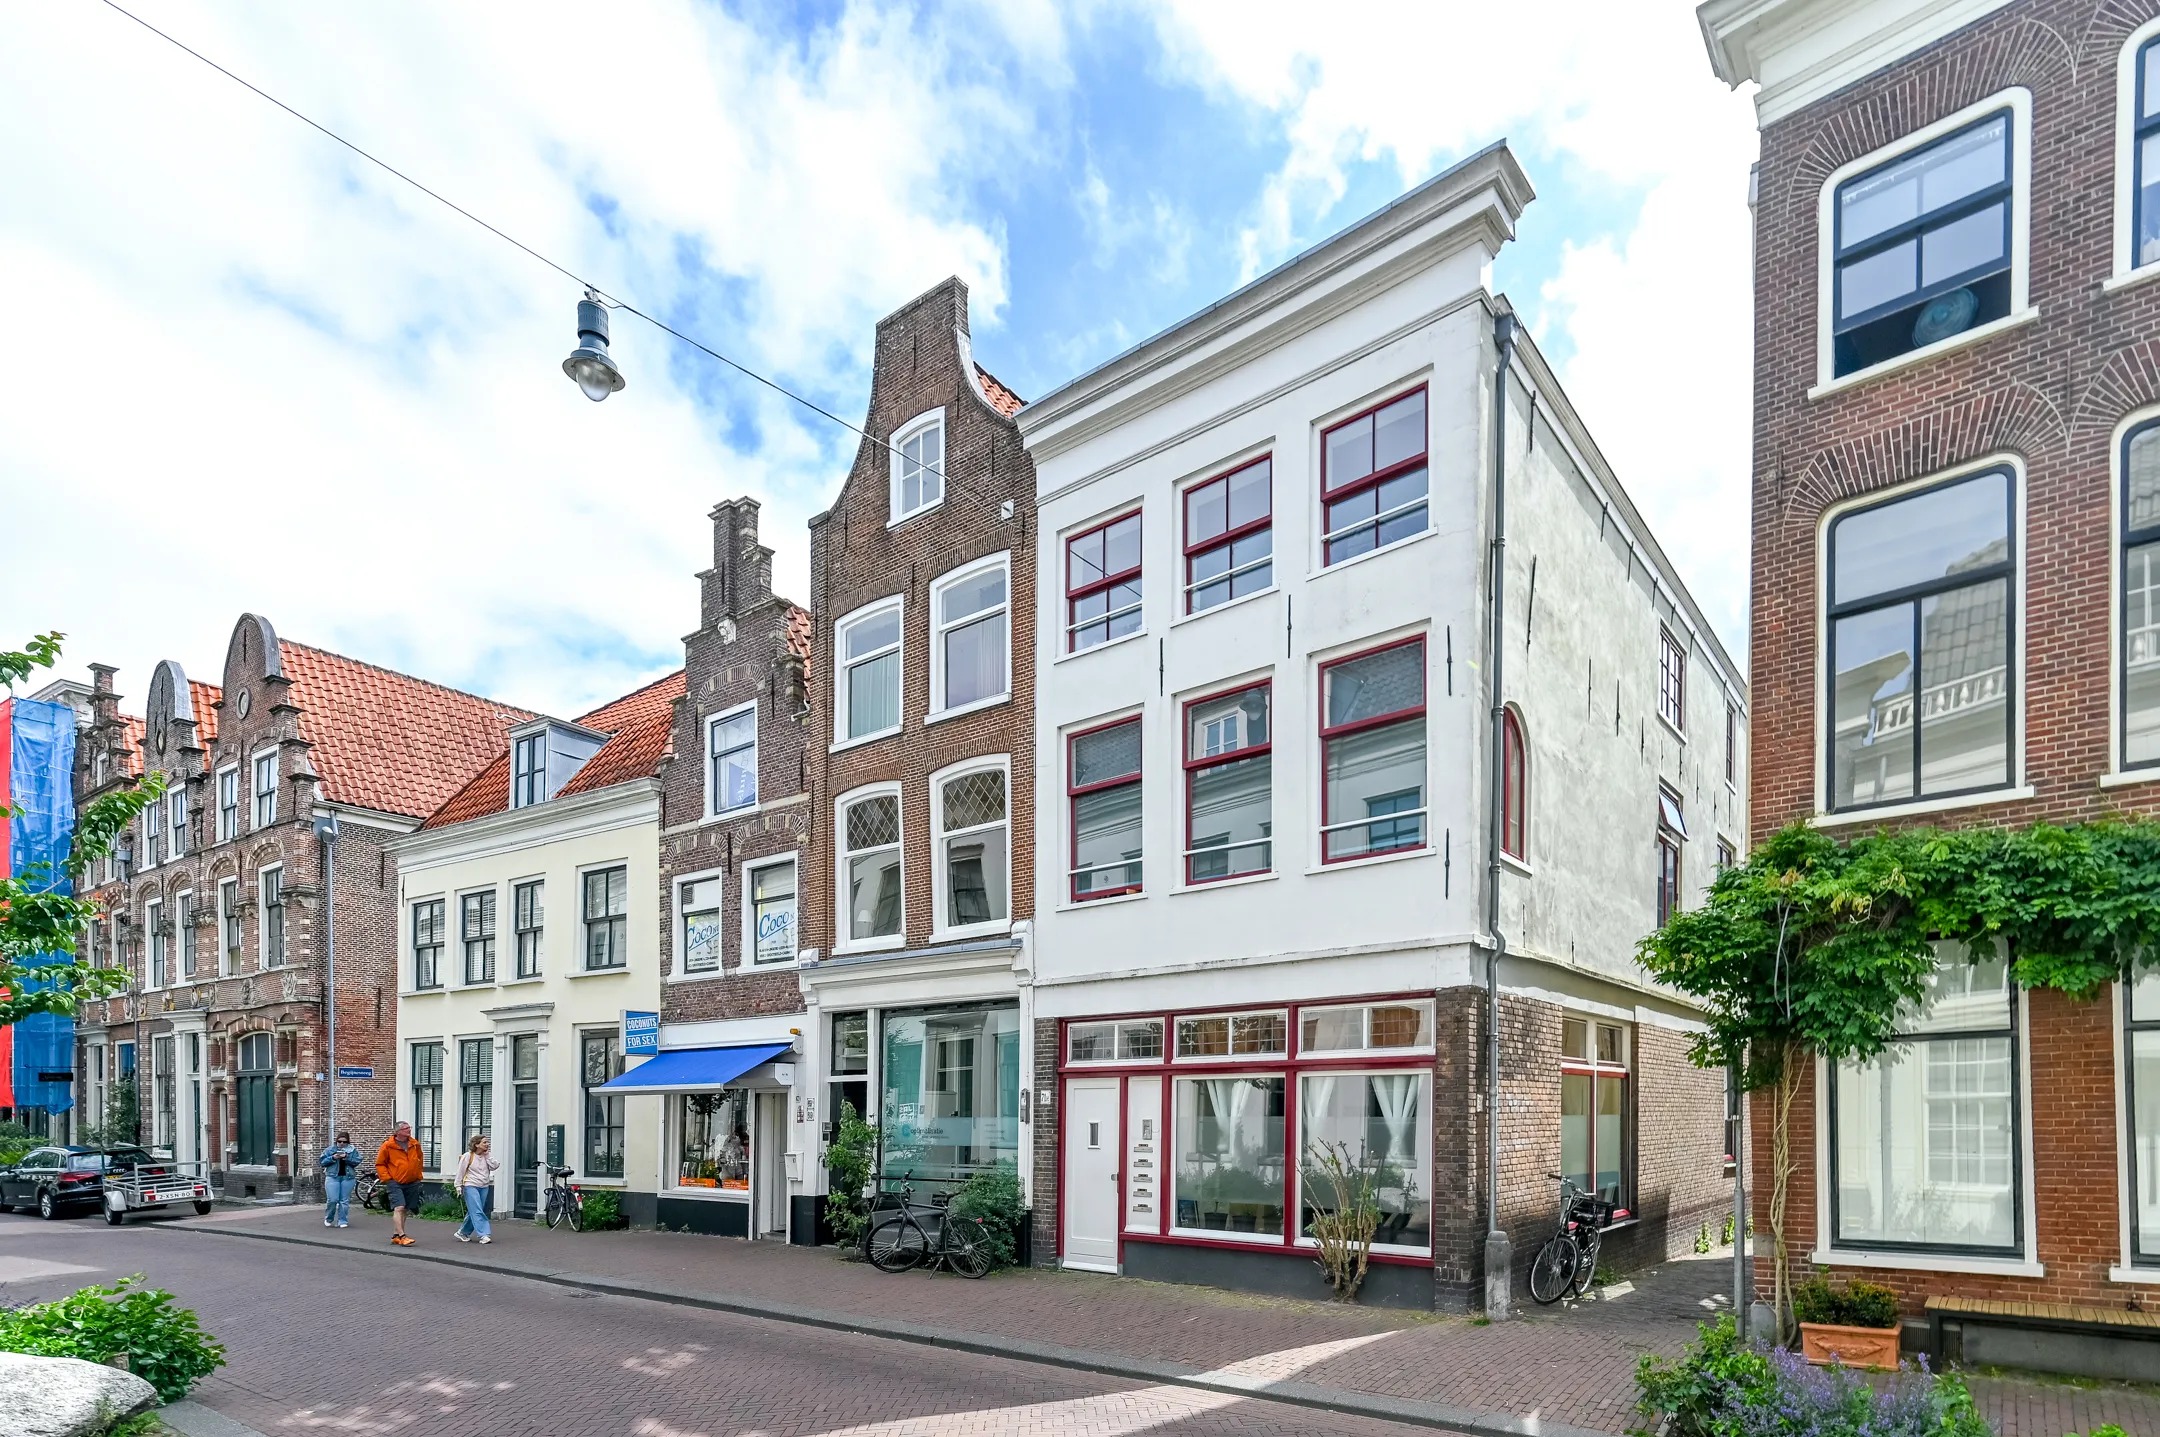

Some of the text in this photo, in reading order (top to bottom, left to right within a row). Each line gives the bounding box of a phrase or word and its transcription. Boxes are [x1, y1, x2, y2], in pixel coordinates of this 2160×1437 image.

[626, 1017, 657, 1030] COCONUTS
[627, 1034, 656, 1047] FOR SEX
